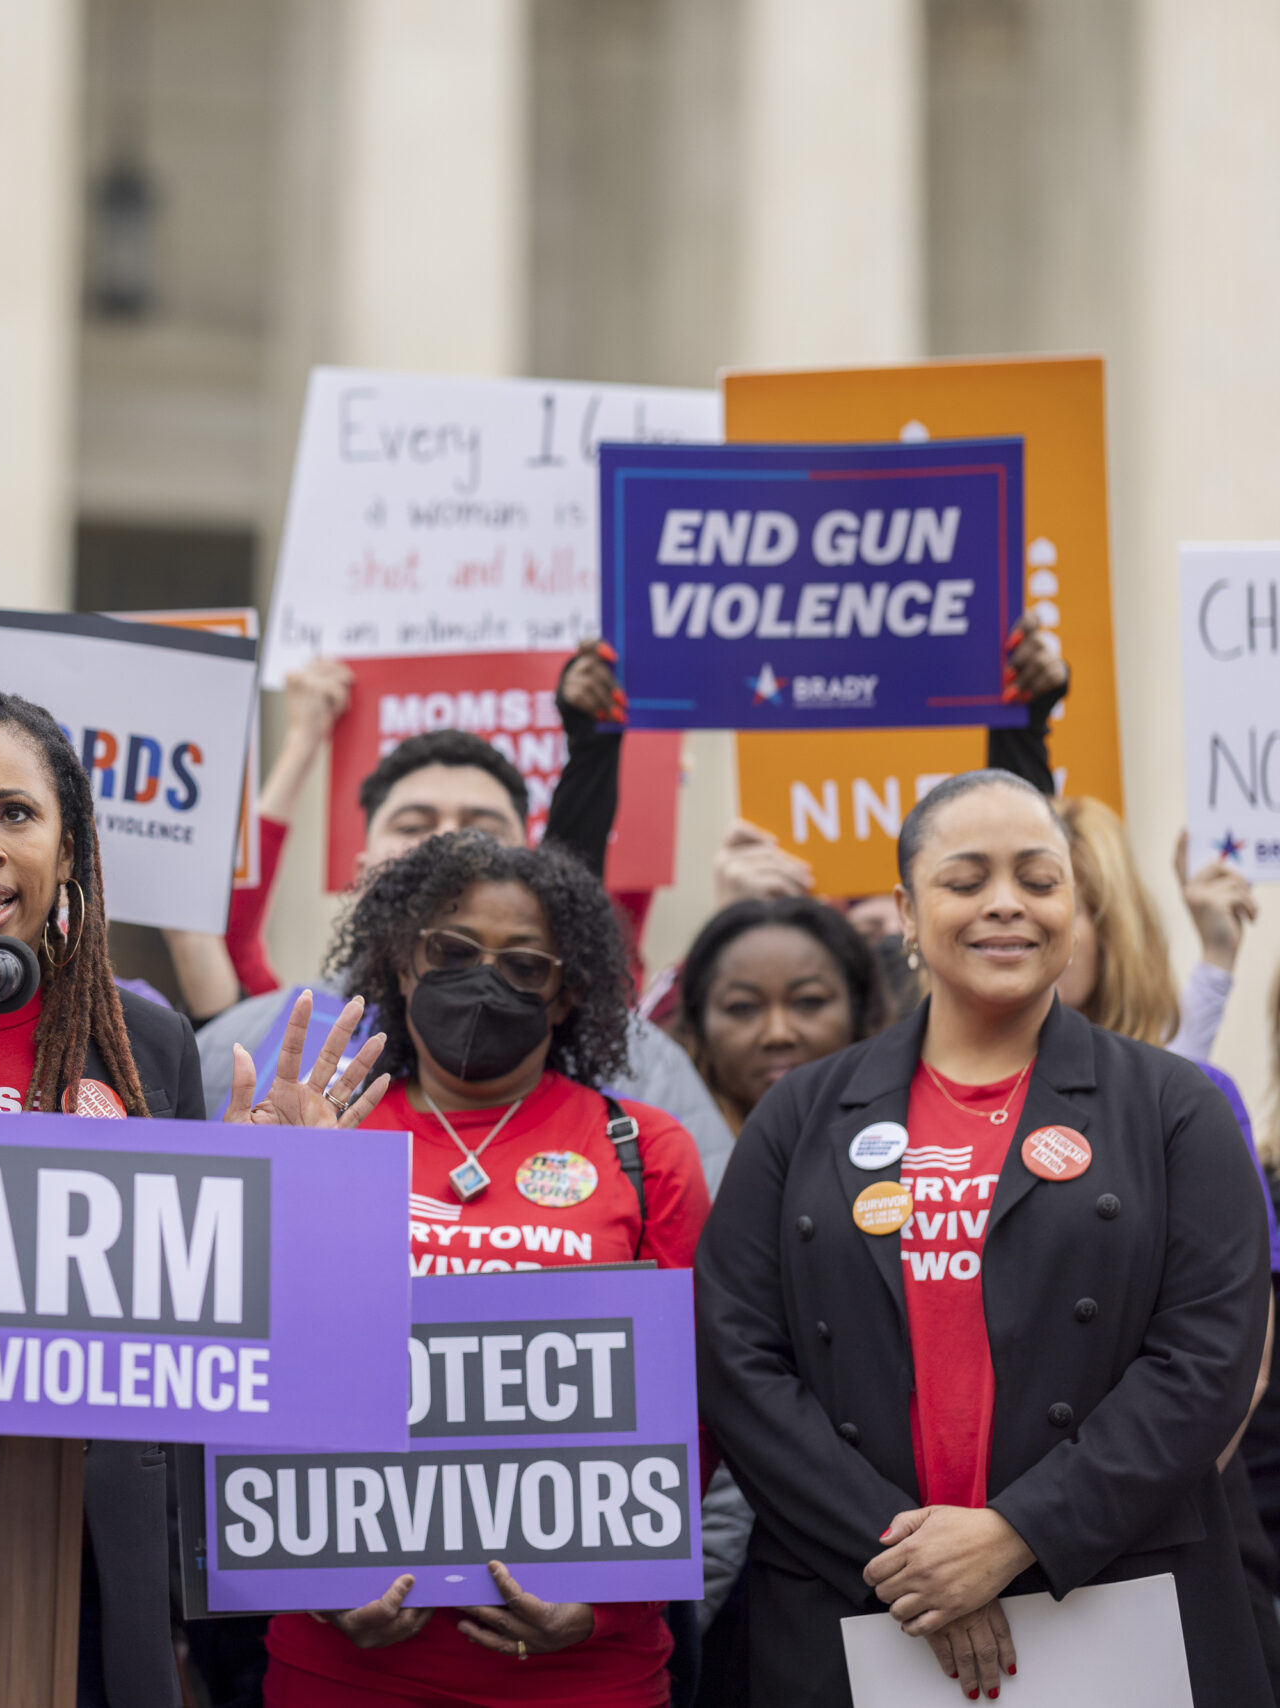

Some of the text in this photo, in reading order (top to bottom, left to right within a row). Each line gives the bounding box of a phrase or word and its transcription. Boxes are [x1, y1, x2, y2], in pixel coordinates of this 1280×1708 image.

[340, 388, 481, 495] Every
[408, 501, 527, 529] woman
[554, 501, 587, 528] is
[657, 506, 961, 567] END GUN
[648, 579, 974, 640] VIOLENCE
[792, 674, 878, 701] BRADY
[379, 688, 532, 734] MOMS
[60, 726, 204, 811] RDS
[107, 813, 195, 845] VIOLENCE
[1032, 1148, 1063, 1172] ACTION
[856, 1195, 909, 1213] SURVIVOR
[224, 1456, 682, 1558] SURVIVORS
